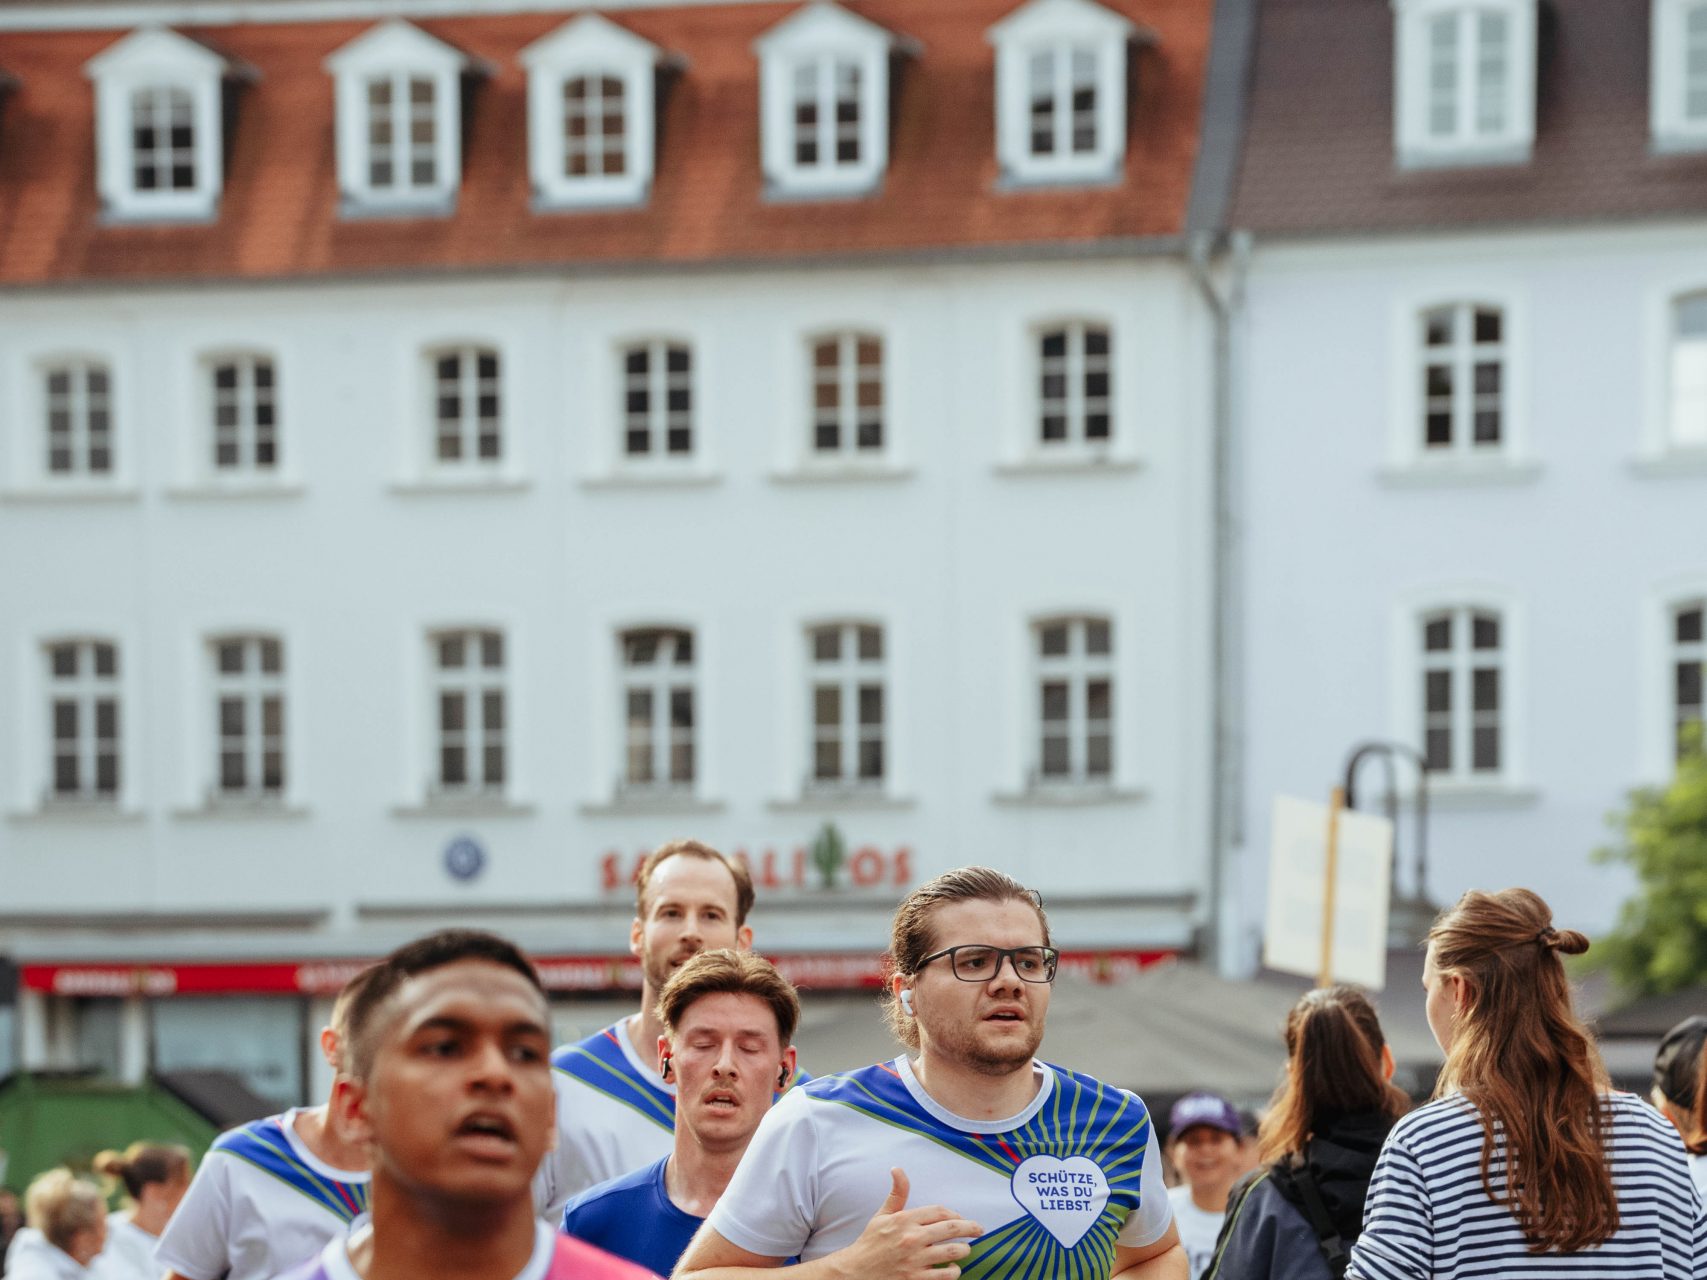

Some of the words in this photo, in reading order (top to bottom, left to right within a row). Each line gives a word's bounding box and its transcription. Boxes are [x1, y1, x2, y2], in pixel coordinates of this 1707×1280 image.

[1028, 1170, 1097, 1188] SCHÜTZE,
[1036, 1186, 1069, 1197] WAS
[1074, 1187, 1093, 1198] DU
[1040, 1199, 1092, 1212] LIEBST.
